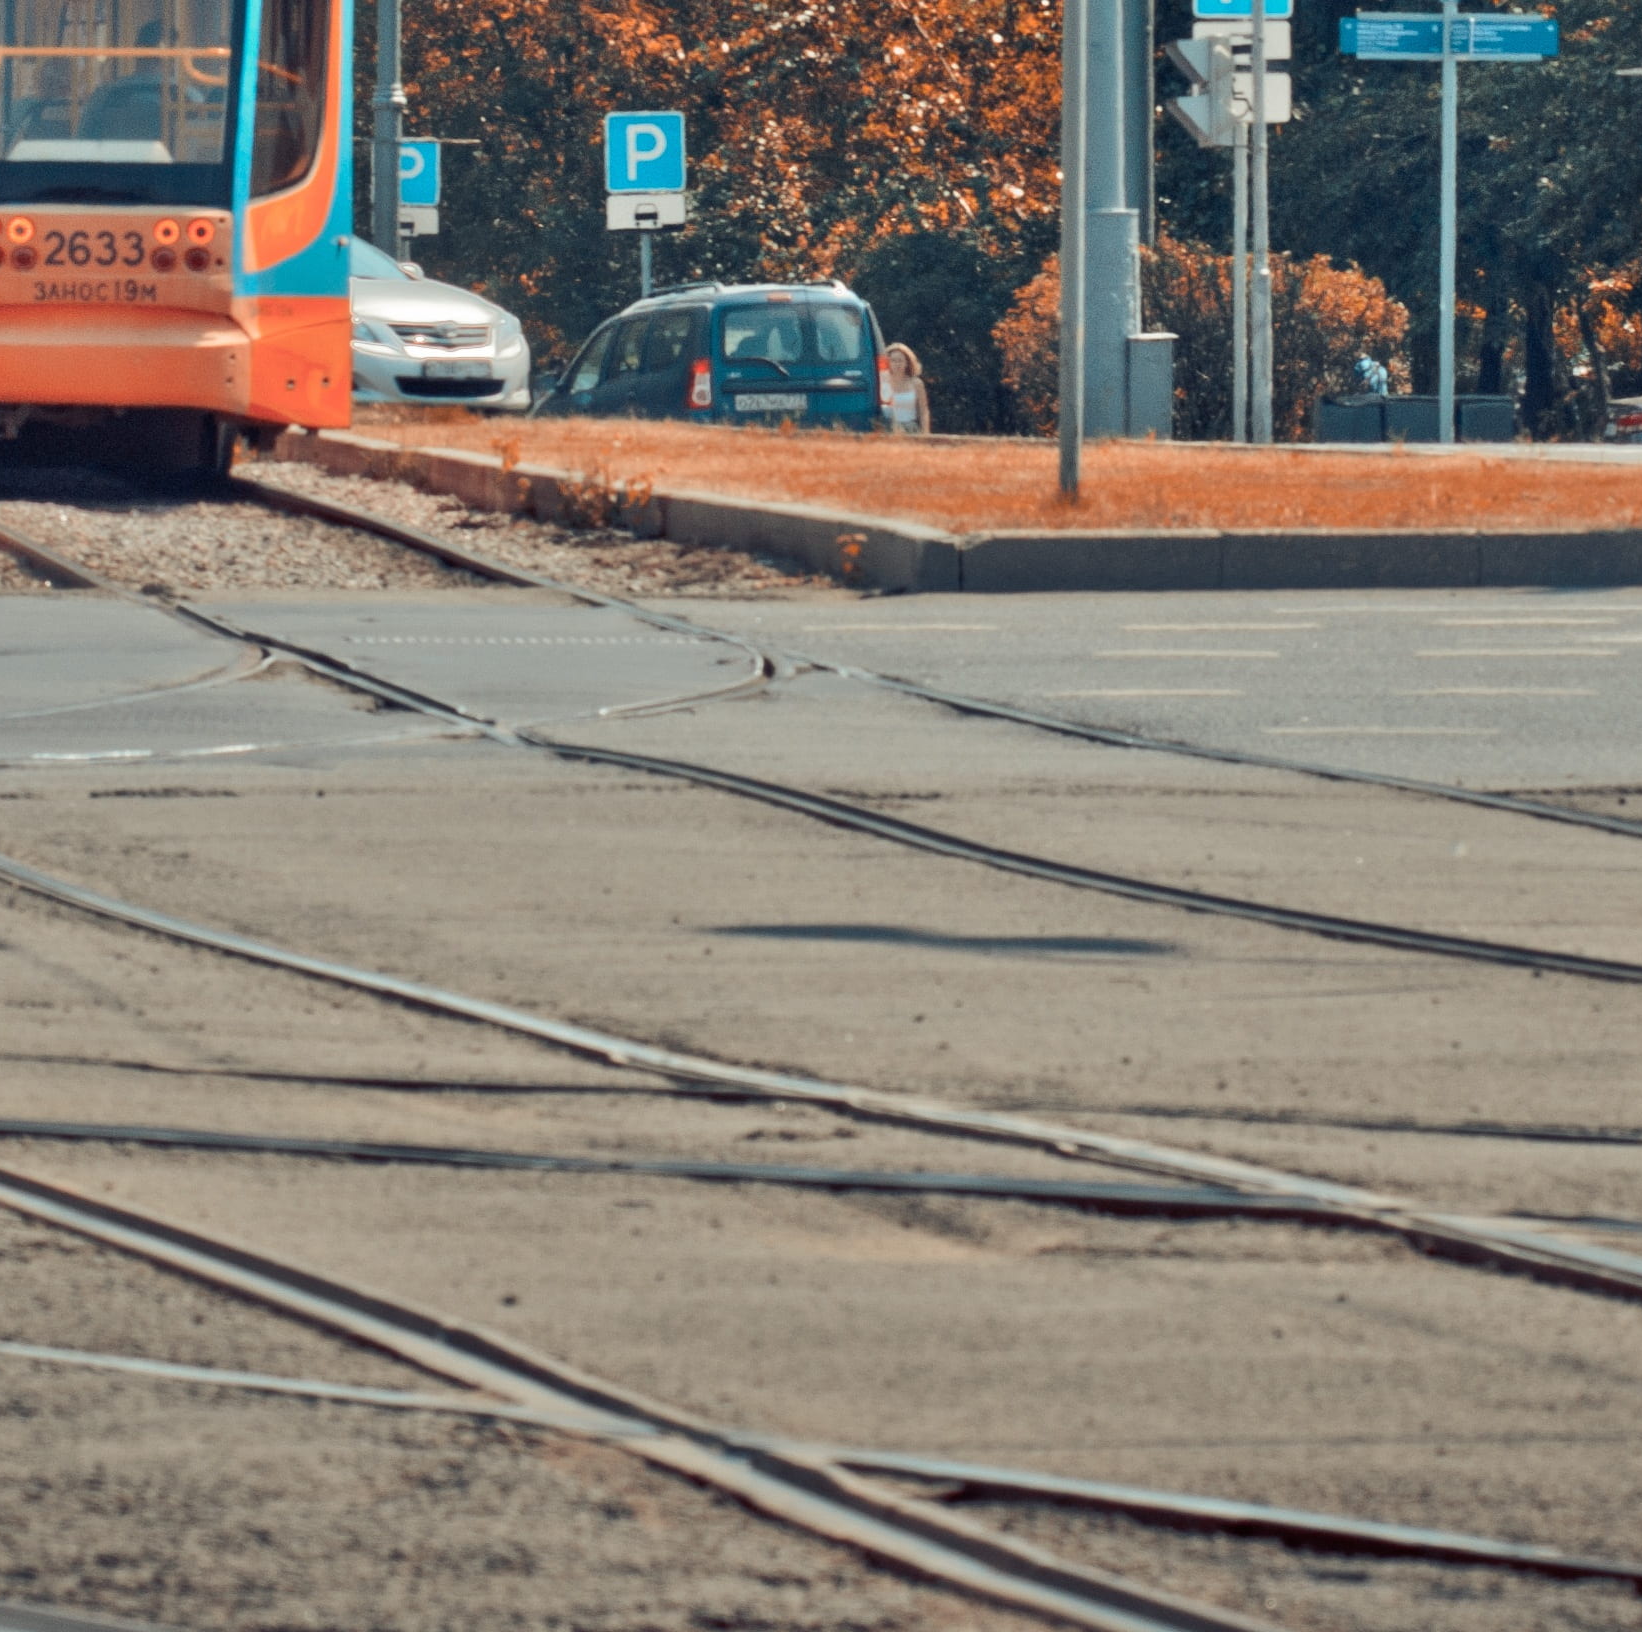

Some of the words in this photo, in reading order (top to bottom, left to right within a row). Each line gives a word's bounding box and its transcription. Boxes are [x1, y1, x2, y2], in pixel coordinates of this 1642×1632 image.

[625, 122, 667, 182] P
[44, 231, 145, 267] 2633
[34, 280, 108, 301] ЗАНОС
